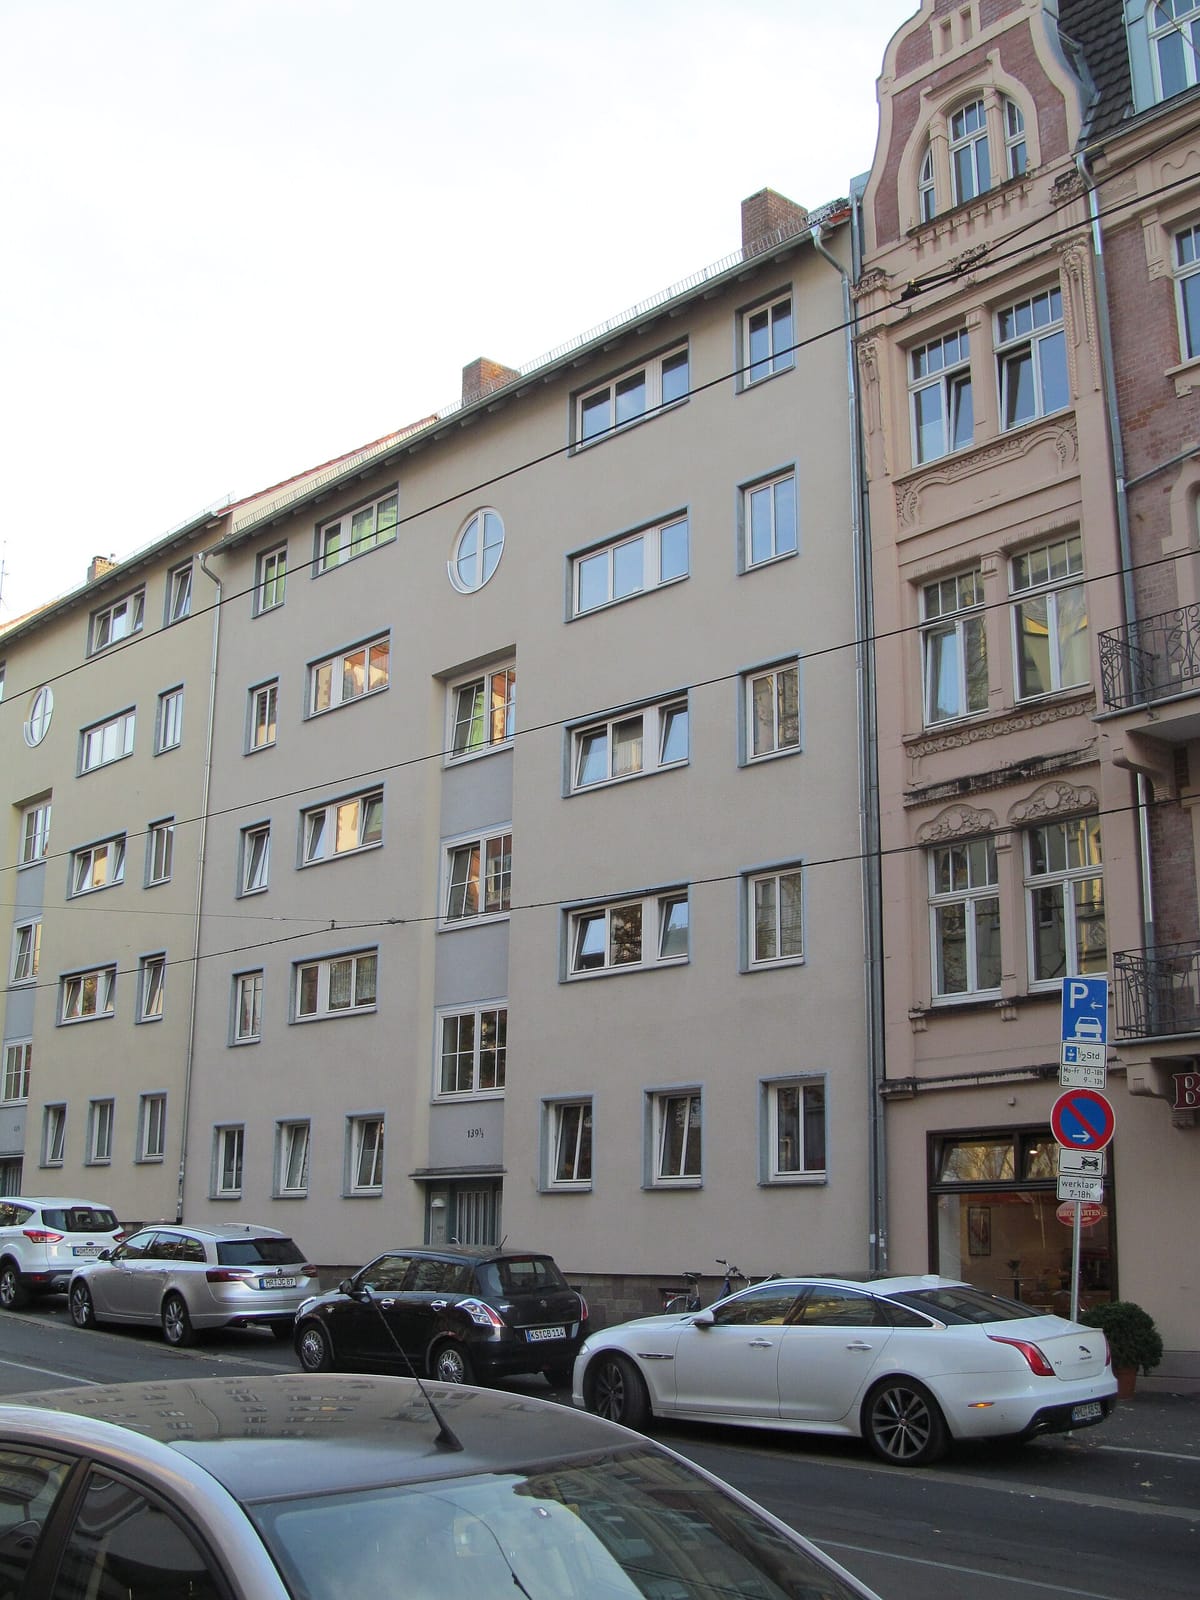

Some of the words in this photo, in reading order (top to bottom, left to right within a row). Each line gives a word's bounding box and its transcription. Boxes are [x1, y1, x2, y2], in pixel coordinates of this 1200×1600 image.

[1070, 982, 1088, 1008] P
[1061, 1180, 1098, 1189] werktag
[1069, 1190, 1091, 1199] 7-18h
